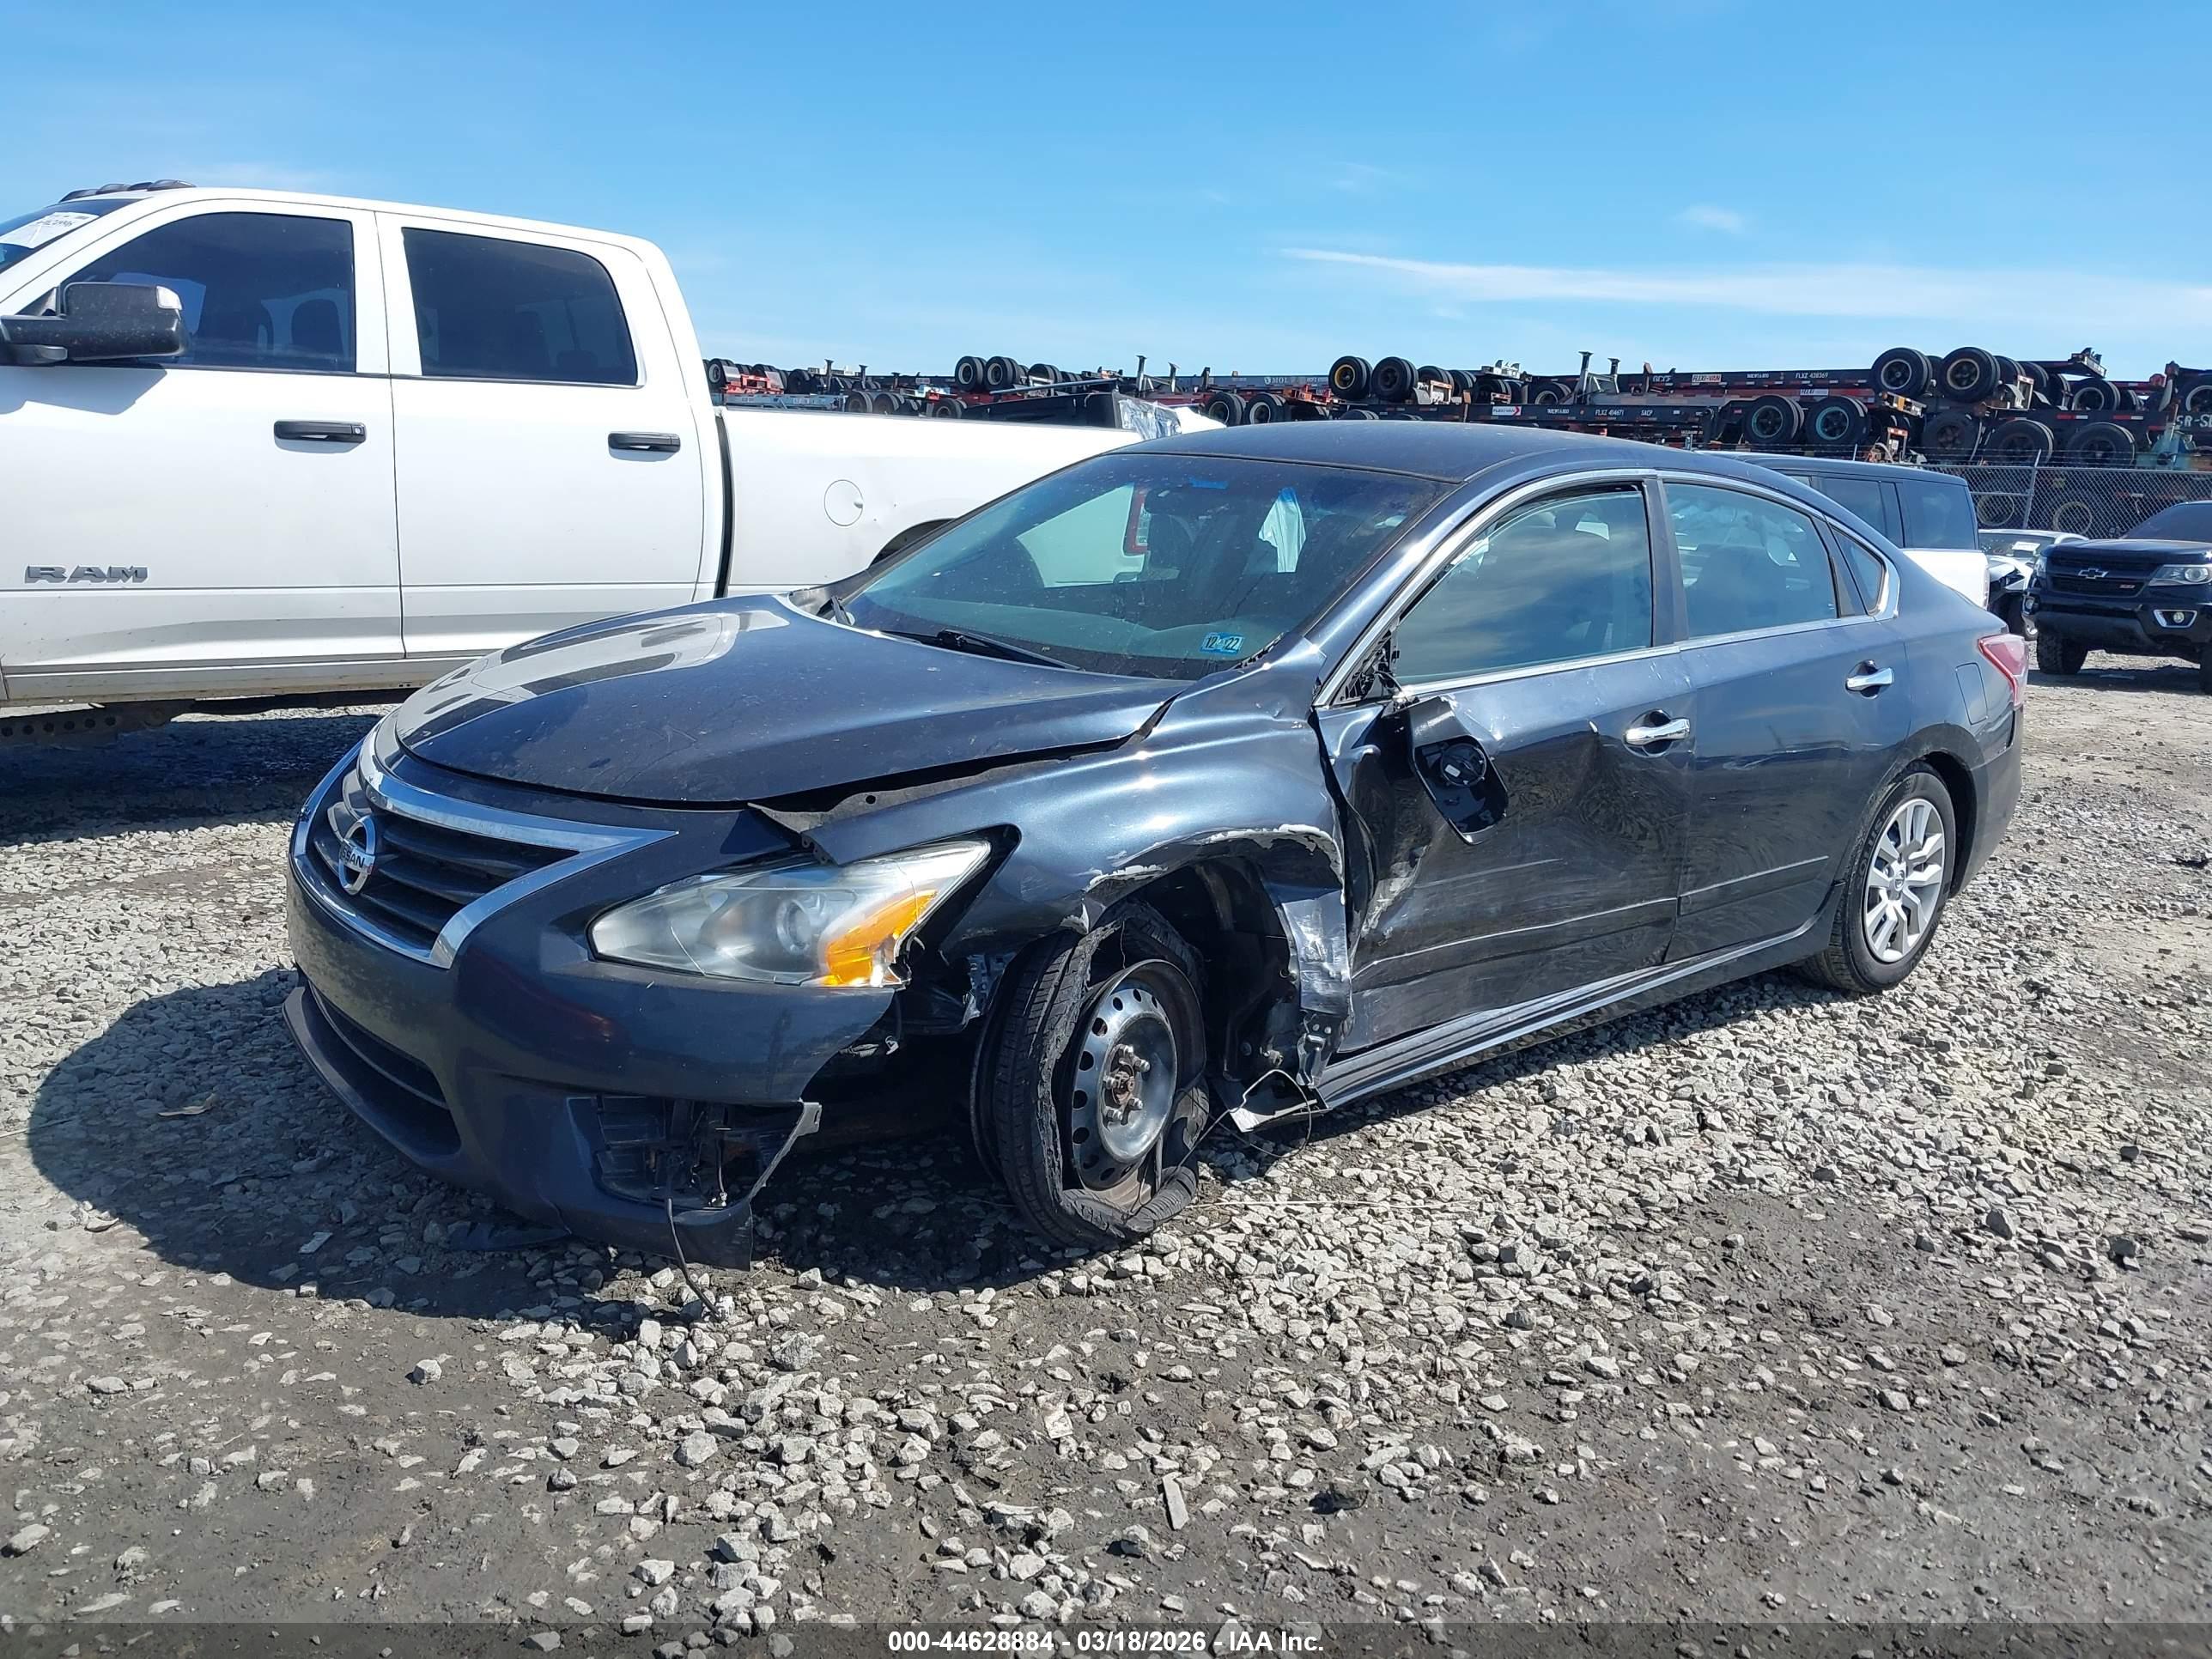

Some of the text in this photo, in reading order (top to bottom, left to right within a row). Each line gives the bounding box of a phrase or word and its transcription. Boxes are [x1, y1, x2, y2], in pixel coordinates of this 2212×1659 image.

[24, 565, 149, 584] RAM
[1205, 636, 1240, 651] 12 22
